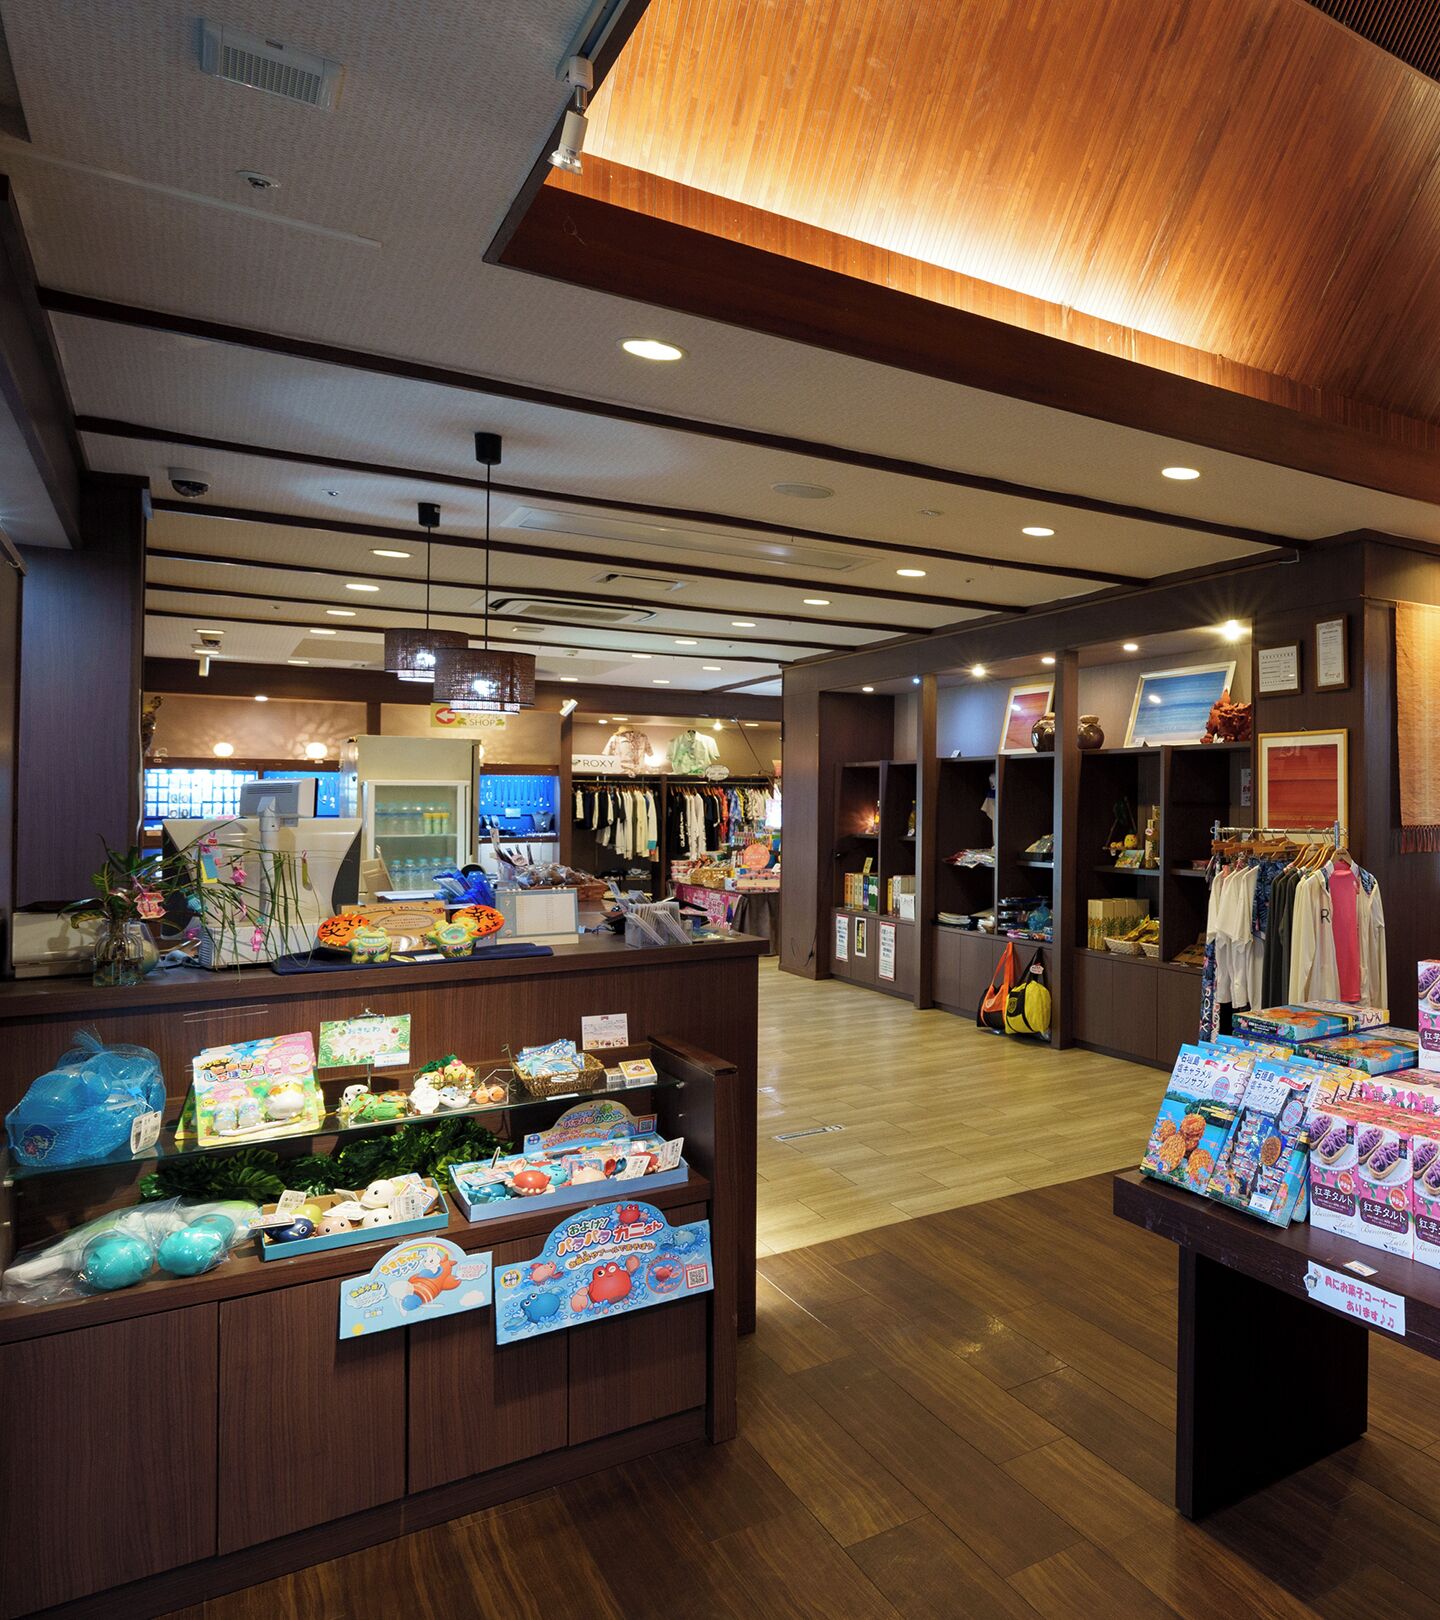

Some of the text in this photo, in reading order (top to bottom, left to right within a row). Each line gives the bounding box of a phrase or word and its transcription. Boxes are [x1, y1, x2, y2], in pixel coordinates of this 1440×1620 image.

[1320, 909, 1330, 923] R
[1201, 987, 1211, 1033] ROXY
[1180, 1053, 1201, 1067] 石垣島
[1254, 1069, 1275, 1083] 石垣島
[1314, 1185, 1353, 1205] 紅芋タルト
[1363, 1201, 1406, 1223] 紅芋タルト
[557, 1220, 662, 1255] パタパタ カニさん
[1347, 1300, 1378, 1322] あります
